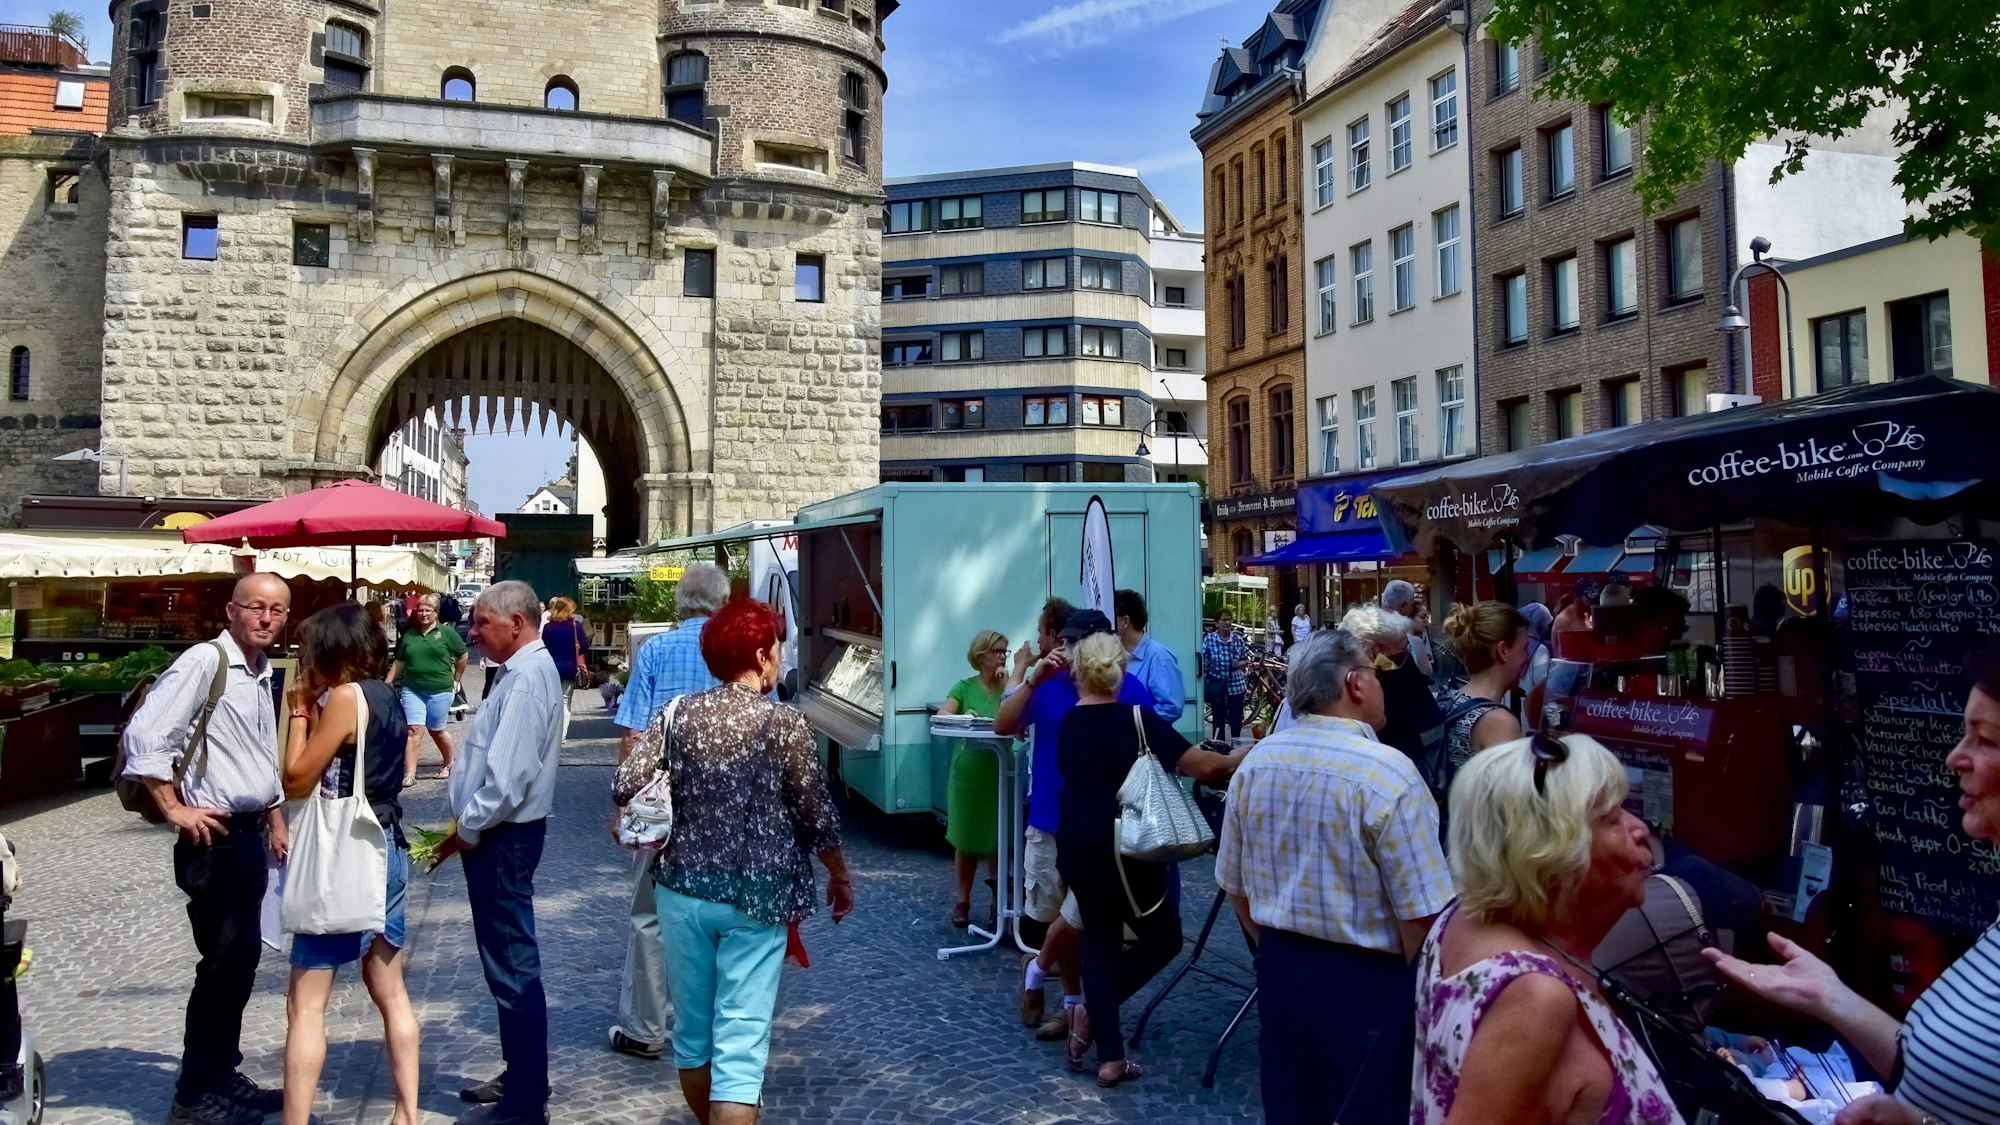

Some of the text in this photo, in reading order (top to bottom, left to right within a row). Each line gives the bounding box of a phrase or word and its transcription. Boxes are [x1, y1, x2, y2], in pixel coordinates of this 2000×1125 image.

[1687, 437, 1845, 486] coffee-bike
[1796, 458, 1925, 483] Mobile Coffee Company
[1426, 492, 1487, 520] coffee-bike
[1467, 516, 1519, 528] Mobile Coffee Company
[1847, 547, 1943, 570] coffee-bike
[1787, 567, 1828, 606] up
[1913, 572, 1993, 583] Mobile Coffee Company
[1850, 589, 1891, 606] Kaffee
[1851, 605, 1900, 622] Espresso
[1936, 607, 1975, 622] doppio
[1851, 619, 1899, 632] Espresso
[1586, 697, 1661, 722] coffee-bike
[1632, 725, 1695, 741] Mobile Coffee Company
[1867, 779, 1916, 796] Othello
[1874, 821, 1907, 843] frisch
[1880, 863, 1909, 887] Alle
[1880, 885, 1916, 904] auch
[1924, 893, 1942, 906] in
[1880, 899, 1909, 913] und
